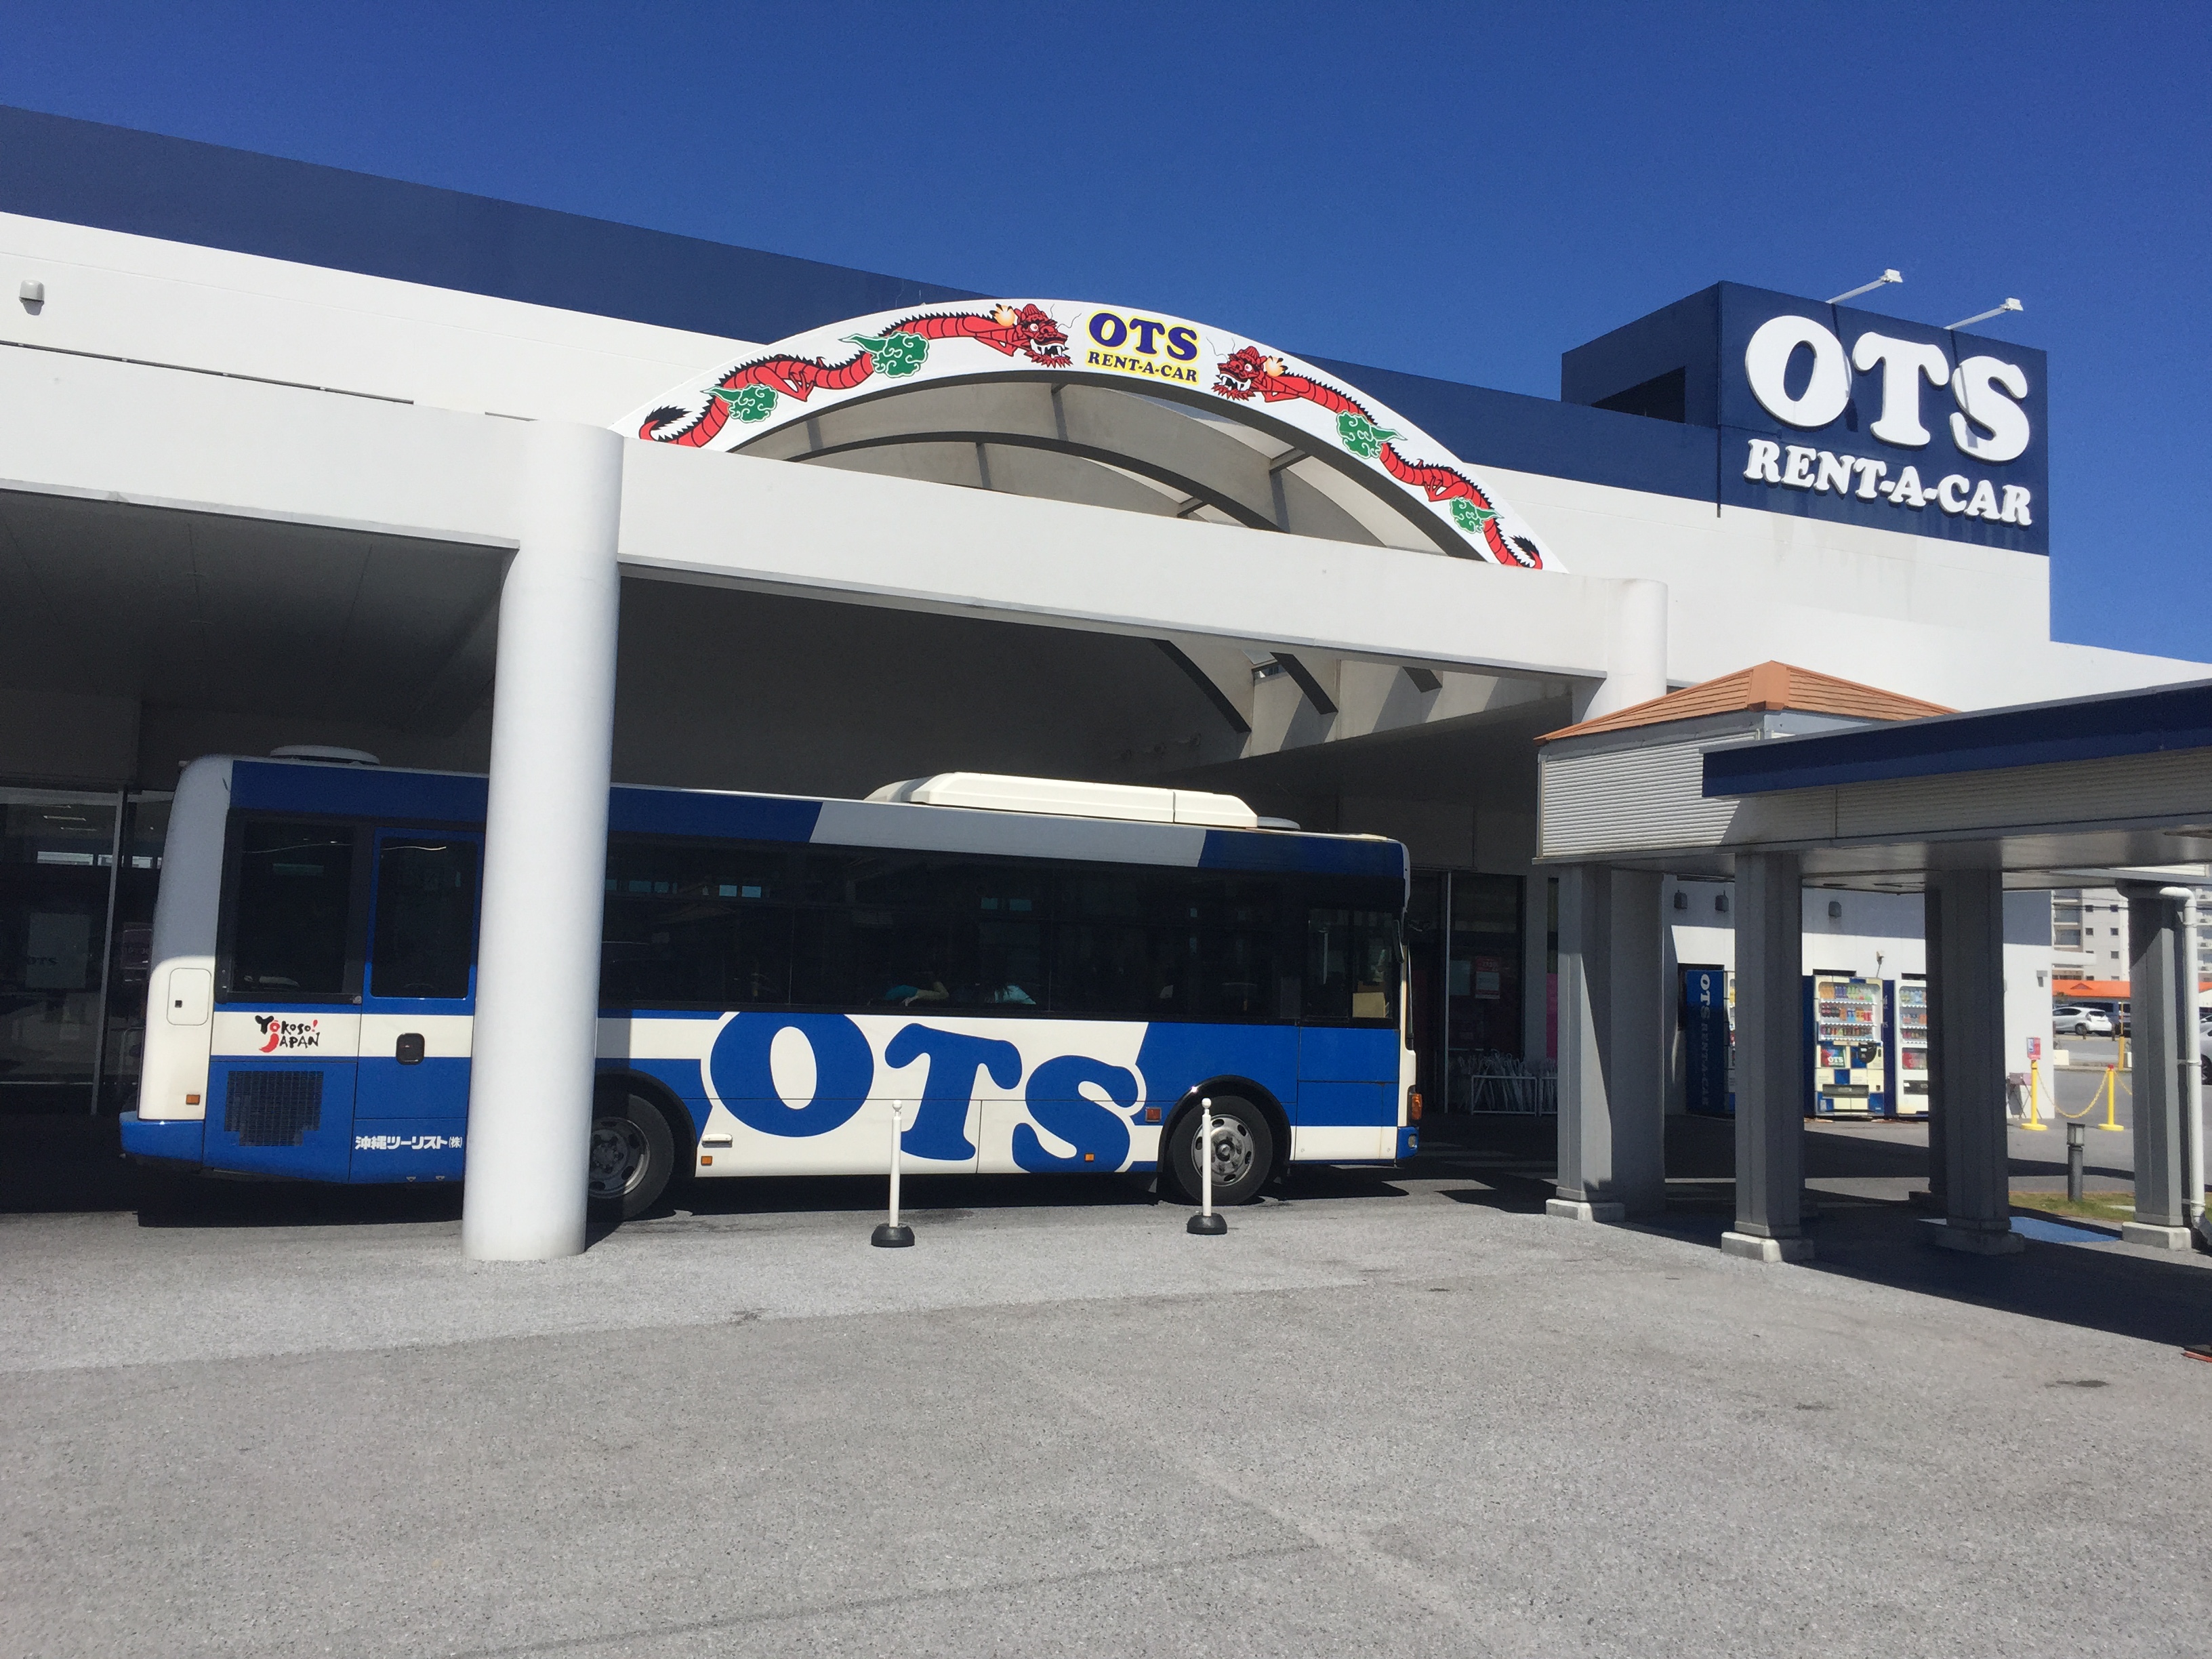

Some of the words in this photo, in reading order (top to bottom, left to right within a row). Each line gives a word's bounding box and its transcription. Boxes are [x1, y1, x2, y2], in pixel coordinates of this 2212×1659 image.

[1088, 312, 1197, 361] OTS
[1088, 351, 1197, 382] RENT-A-CAR
[1745, 315, 2030, 462] OTS
[1743, 438, 2032, 526] RENT-A-CAR
[1700, 974, 1711, 1019] OTS
[259, 1032, 320, 1052] JAPAN
[710, 1012, 1139, 1173] OTS
